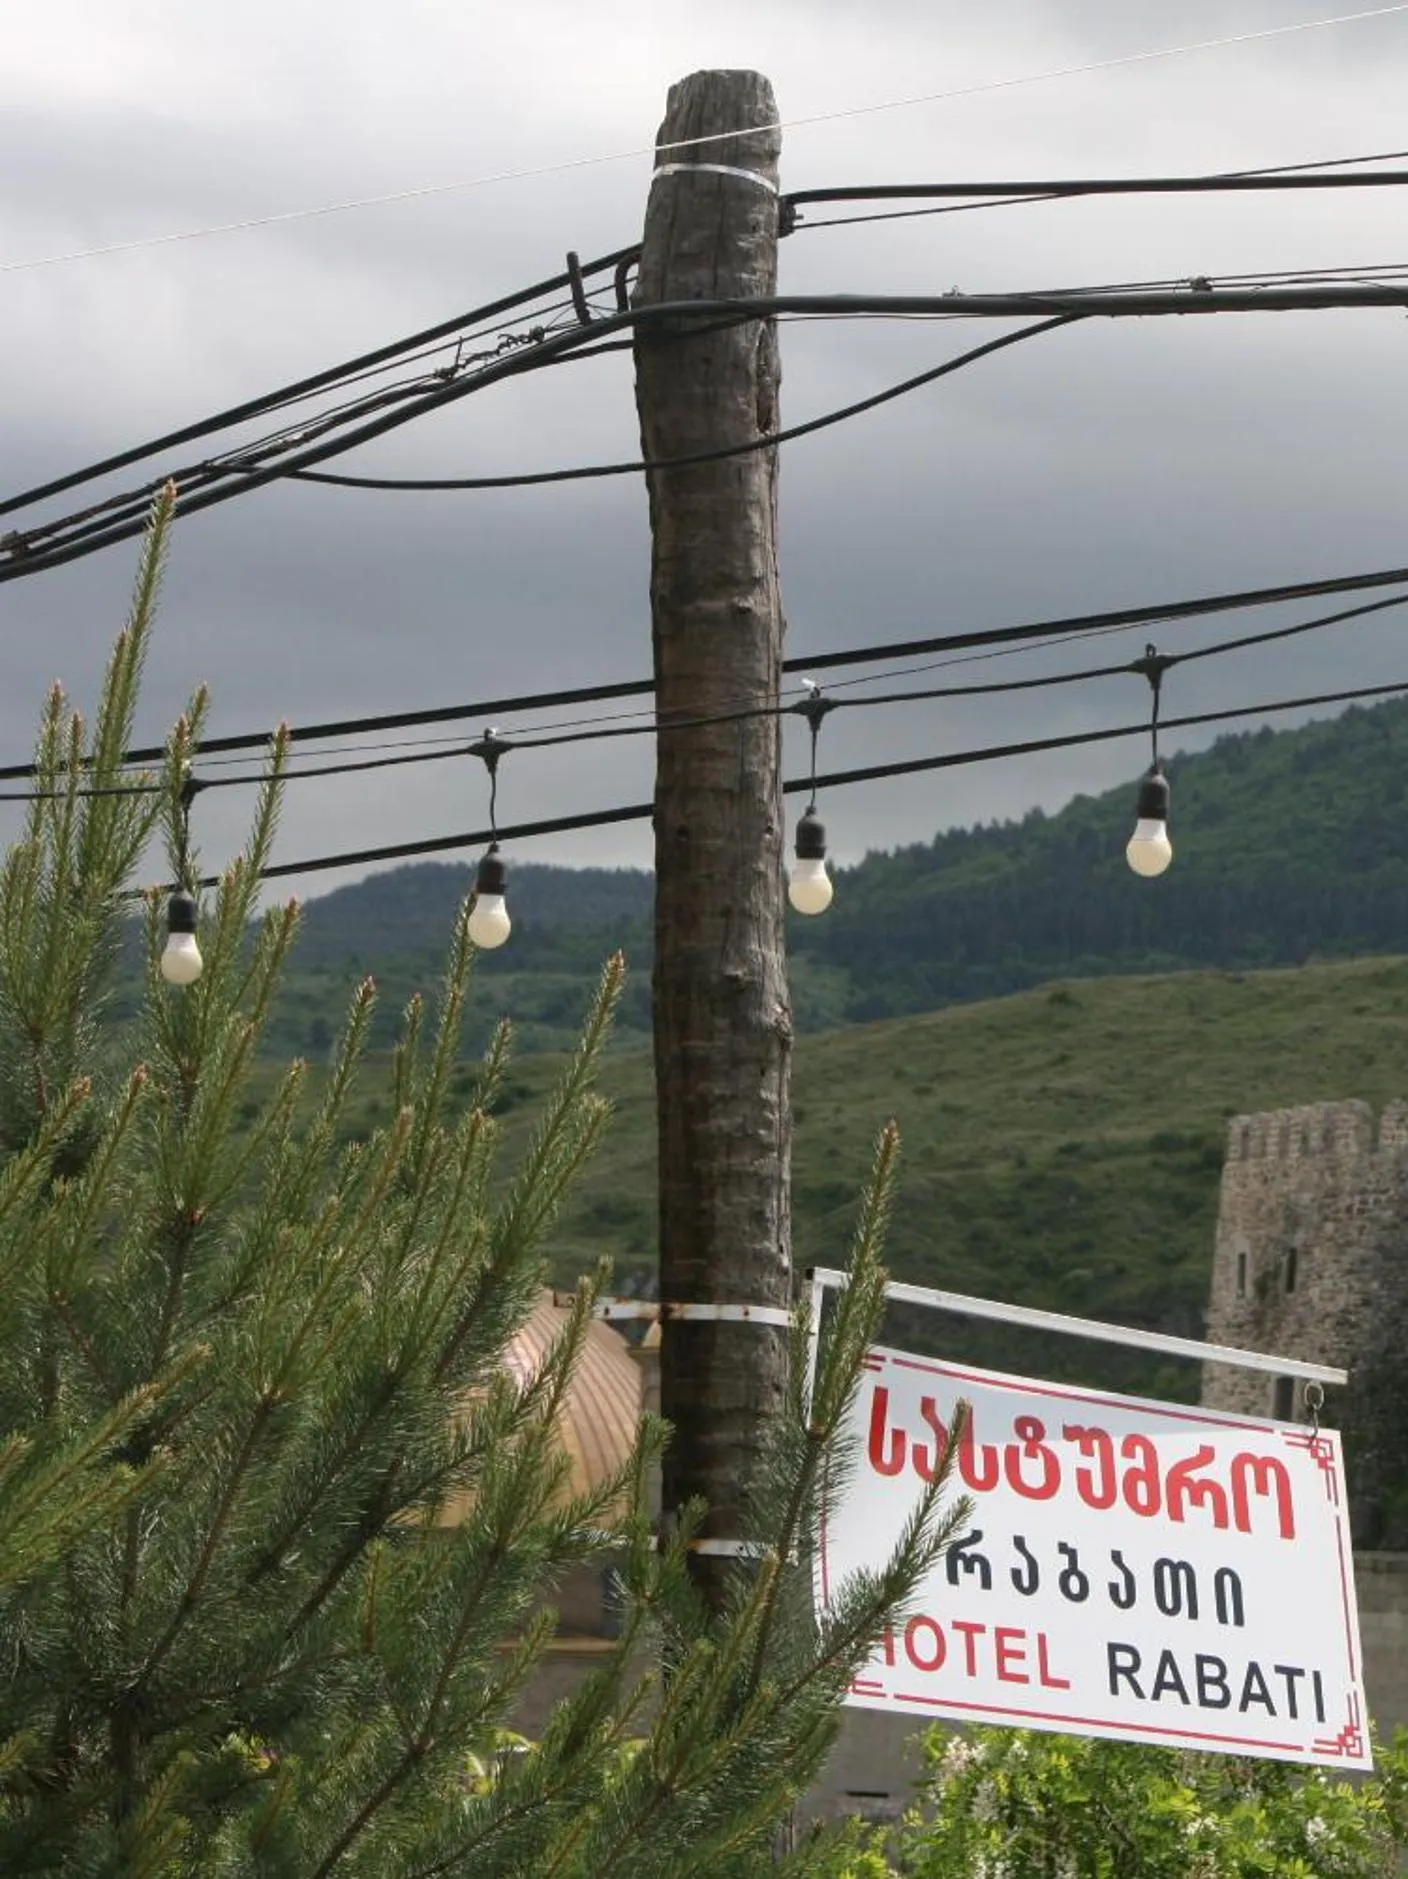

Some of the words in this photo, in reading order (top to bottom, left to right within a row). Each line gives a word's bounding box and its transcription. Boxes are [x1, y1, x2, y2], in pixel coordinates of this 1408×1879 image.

[867, 1386, 1295, 1539] სასტუმრო
[944, 1529, 1245, 1628] რაბათი
[1106, 1641, 1327, 1723] RABATI
